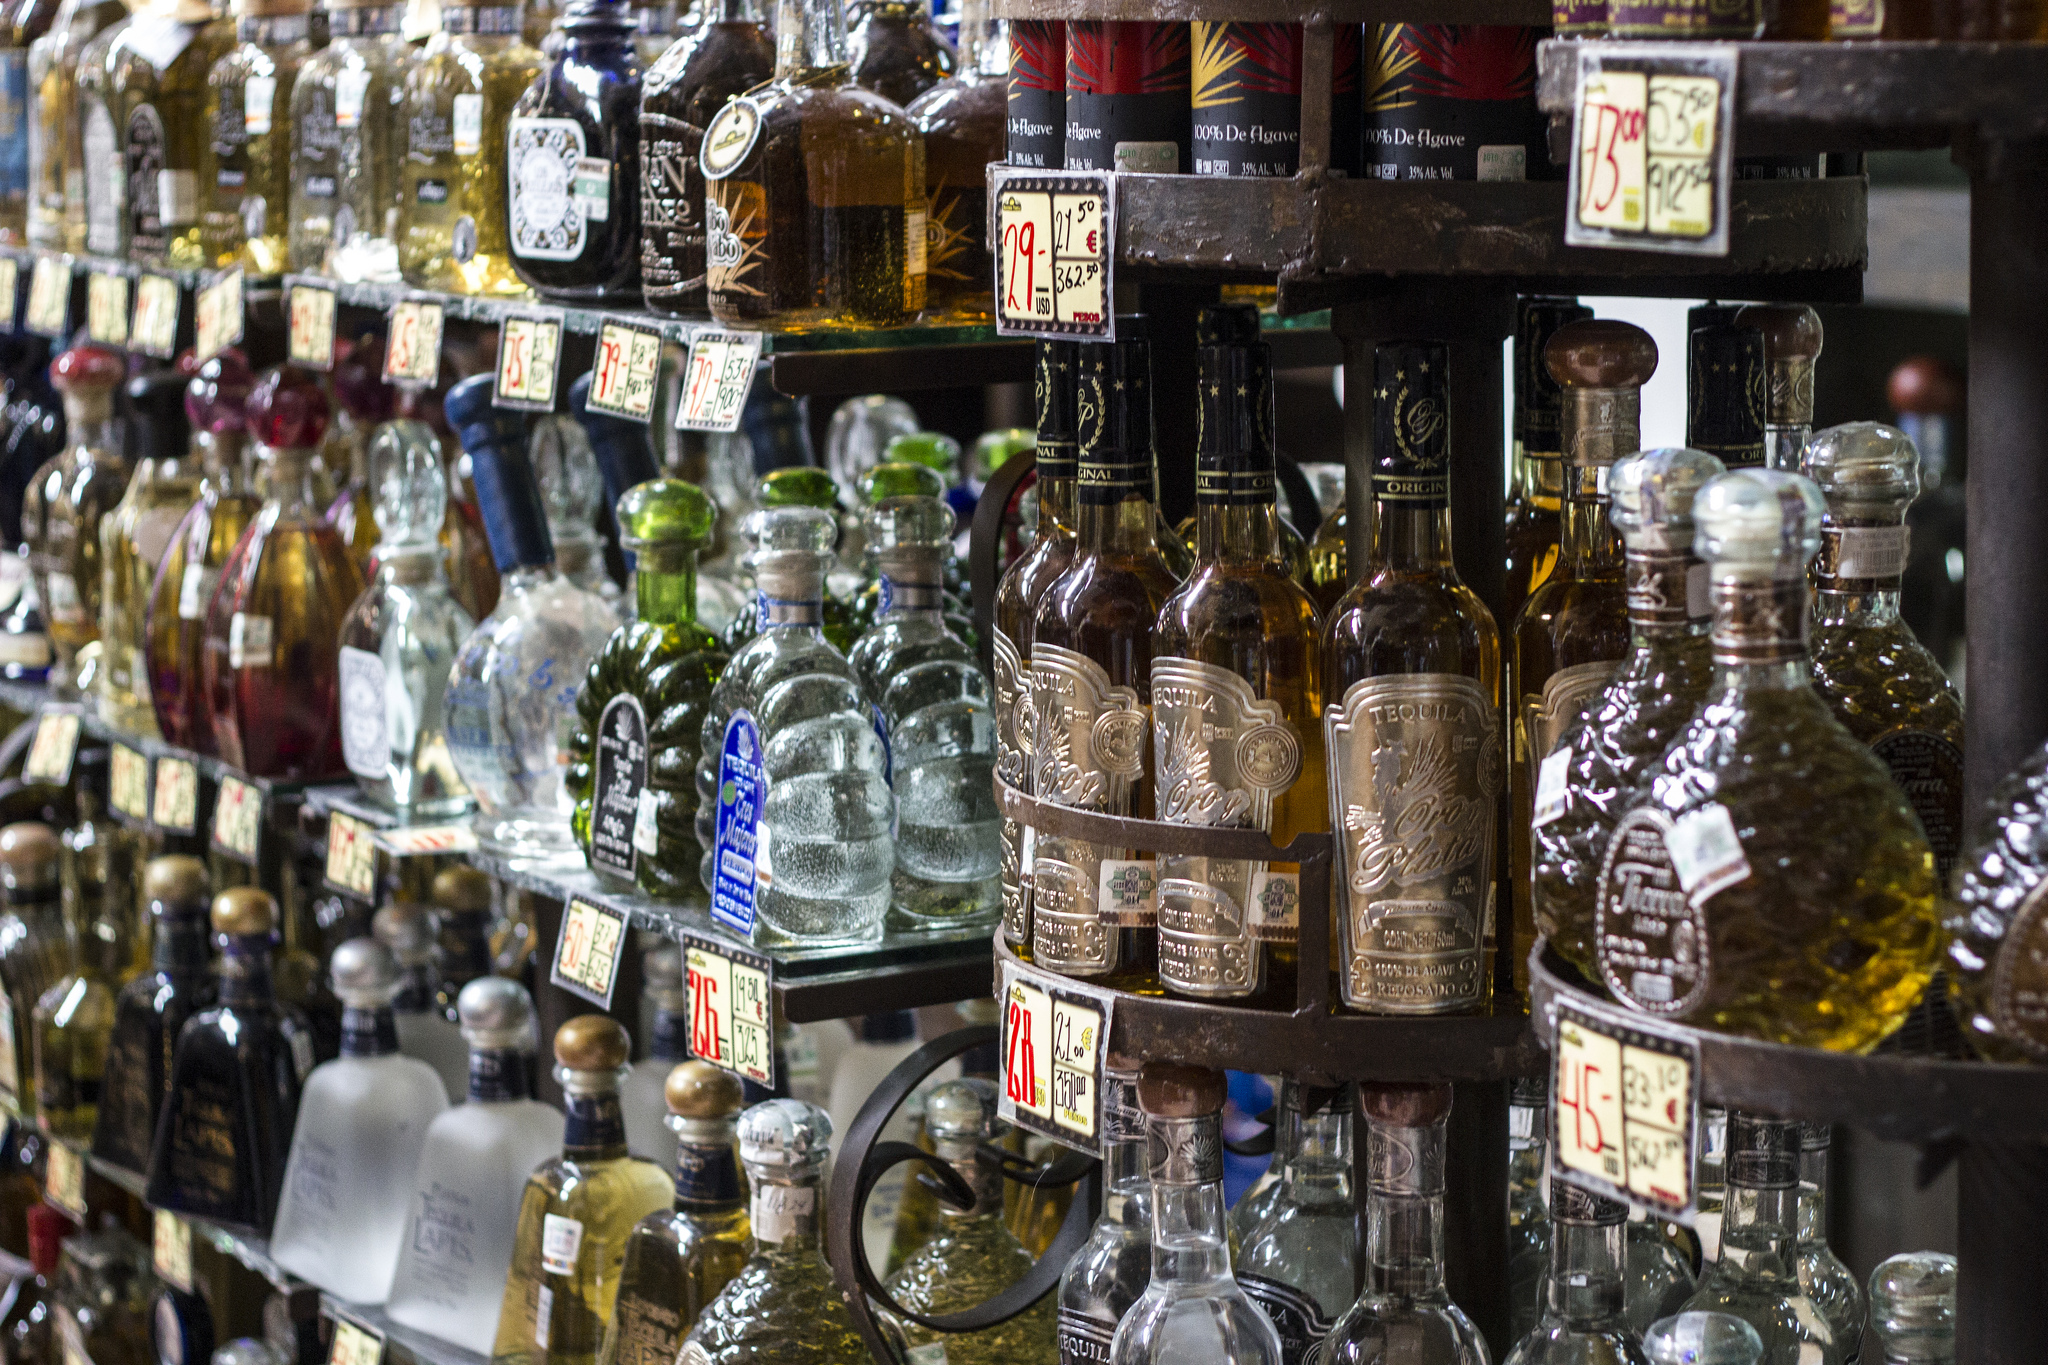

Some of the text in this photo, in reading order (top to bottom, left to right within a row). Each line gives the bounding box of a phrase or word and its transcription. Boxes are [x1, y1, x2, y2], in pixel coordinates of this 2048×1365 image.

[1019, 118, 1053, 137] Agave
[1072, 121, 1101, 141] Agave
[1194, 124, 1298, 144] 100% De Agave
[1394, 127, 1415, 145] De
[1417, 128, 1466, 148] Agave
[1409, 166, 1424, 179] 35%
[1036, 297, 1051, 315] USD
[1073, 311, 1100, 322] PESOS
[1153, 687, 1218, 714] TEQUILA
[1369, 703, 1467, 725] TEQUILA
[1393, 793, 1464, 839] Oro
[1188, 945, 1219, 960] AGAVE
[1375, 962, 1456, 977] 100% DE AGAVE
[1376, 981, 1456, 997] REPOSADO
[1007, 1002, 1036, 1107] 28
[1063, 1108, 1088, 1126] PESOS
[1060, 1333, 1111, 1364] TEQUIL
